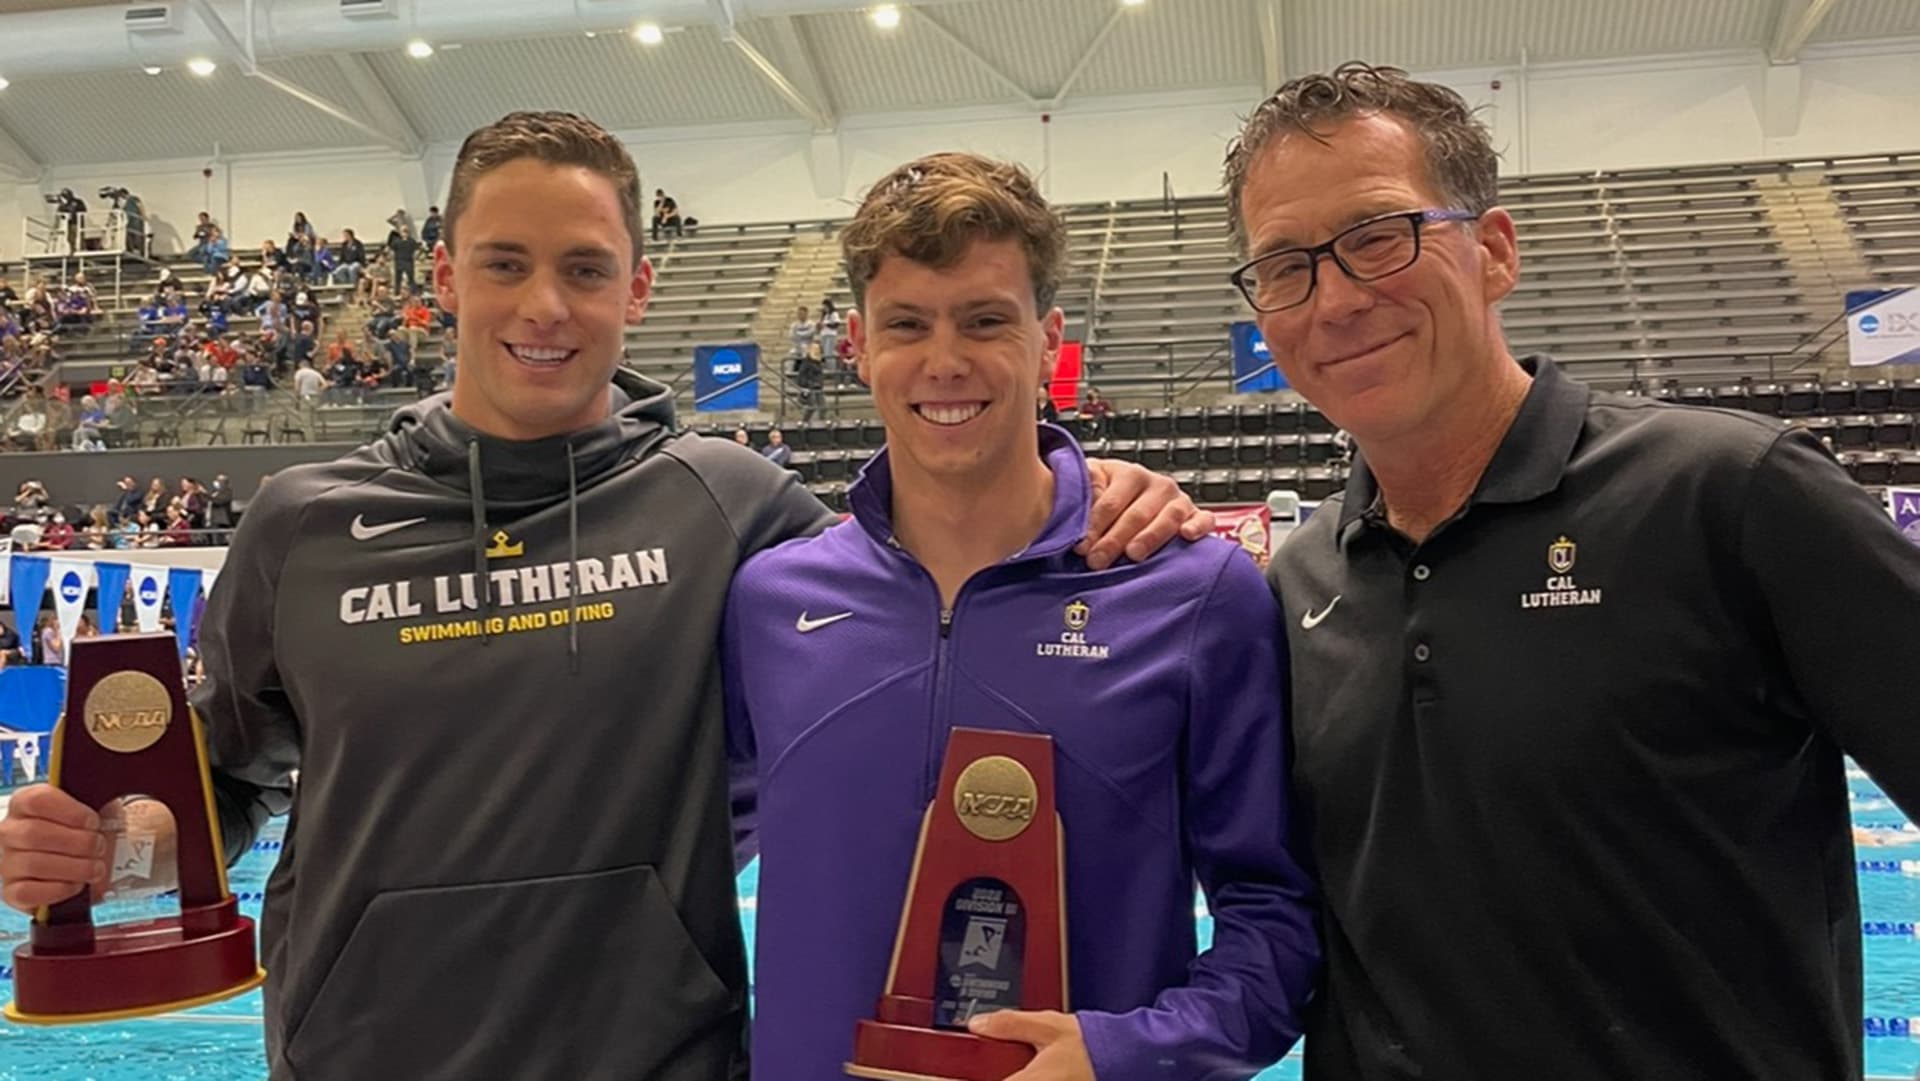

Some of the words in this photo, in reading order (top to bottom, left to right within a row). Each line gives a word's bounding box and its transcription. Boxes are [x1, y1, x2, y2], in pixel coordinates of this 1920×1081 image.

[339, 580, 422, 624] CAL
[434, 547, 670, 614] LUTHERAN
[1546, 576, 1577, 591] CAL
[1521, 589, 1602, 608] LUTHERAN
[399, 617, 505, 644] SWIMMING
[507, 612, 547, 632] AND
[550, 601, 615, 626] DIVING
[1061, 632, 1087, 644] CAL
[1037, 643, 1109, 658] LUTHERAN
[92, 709, 168, 732] NCAA
[960, 791, 1034, 821] NCAA
